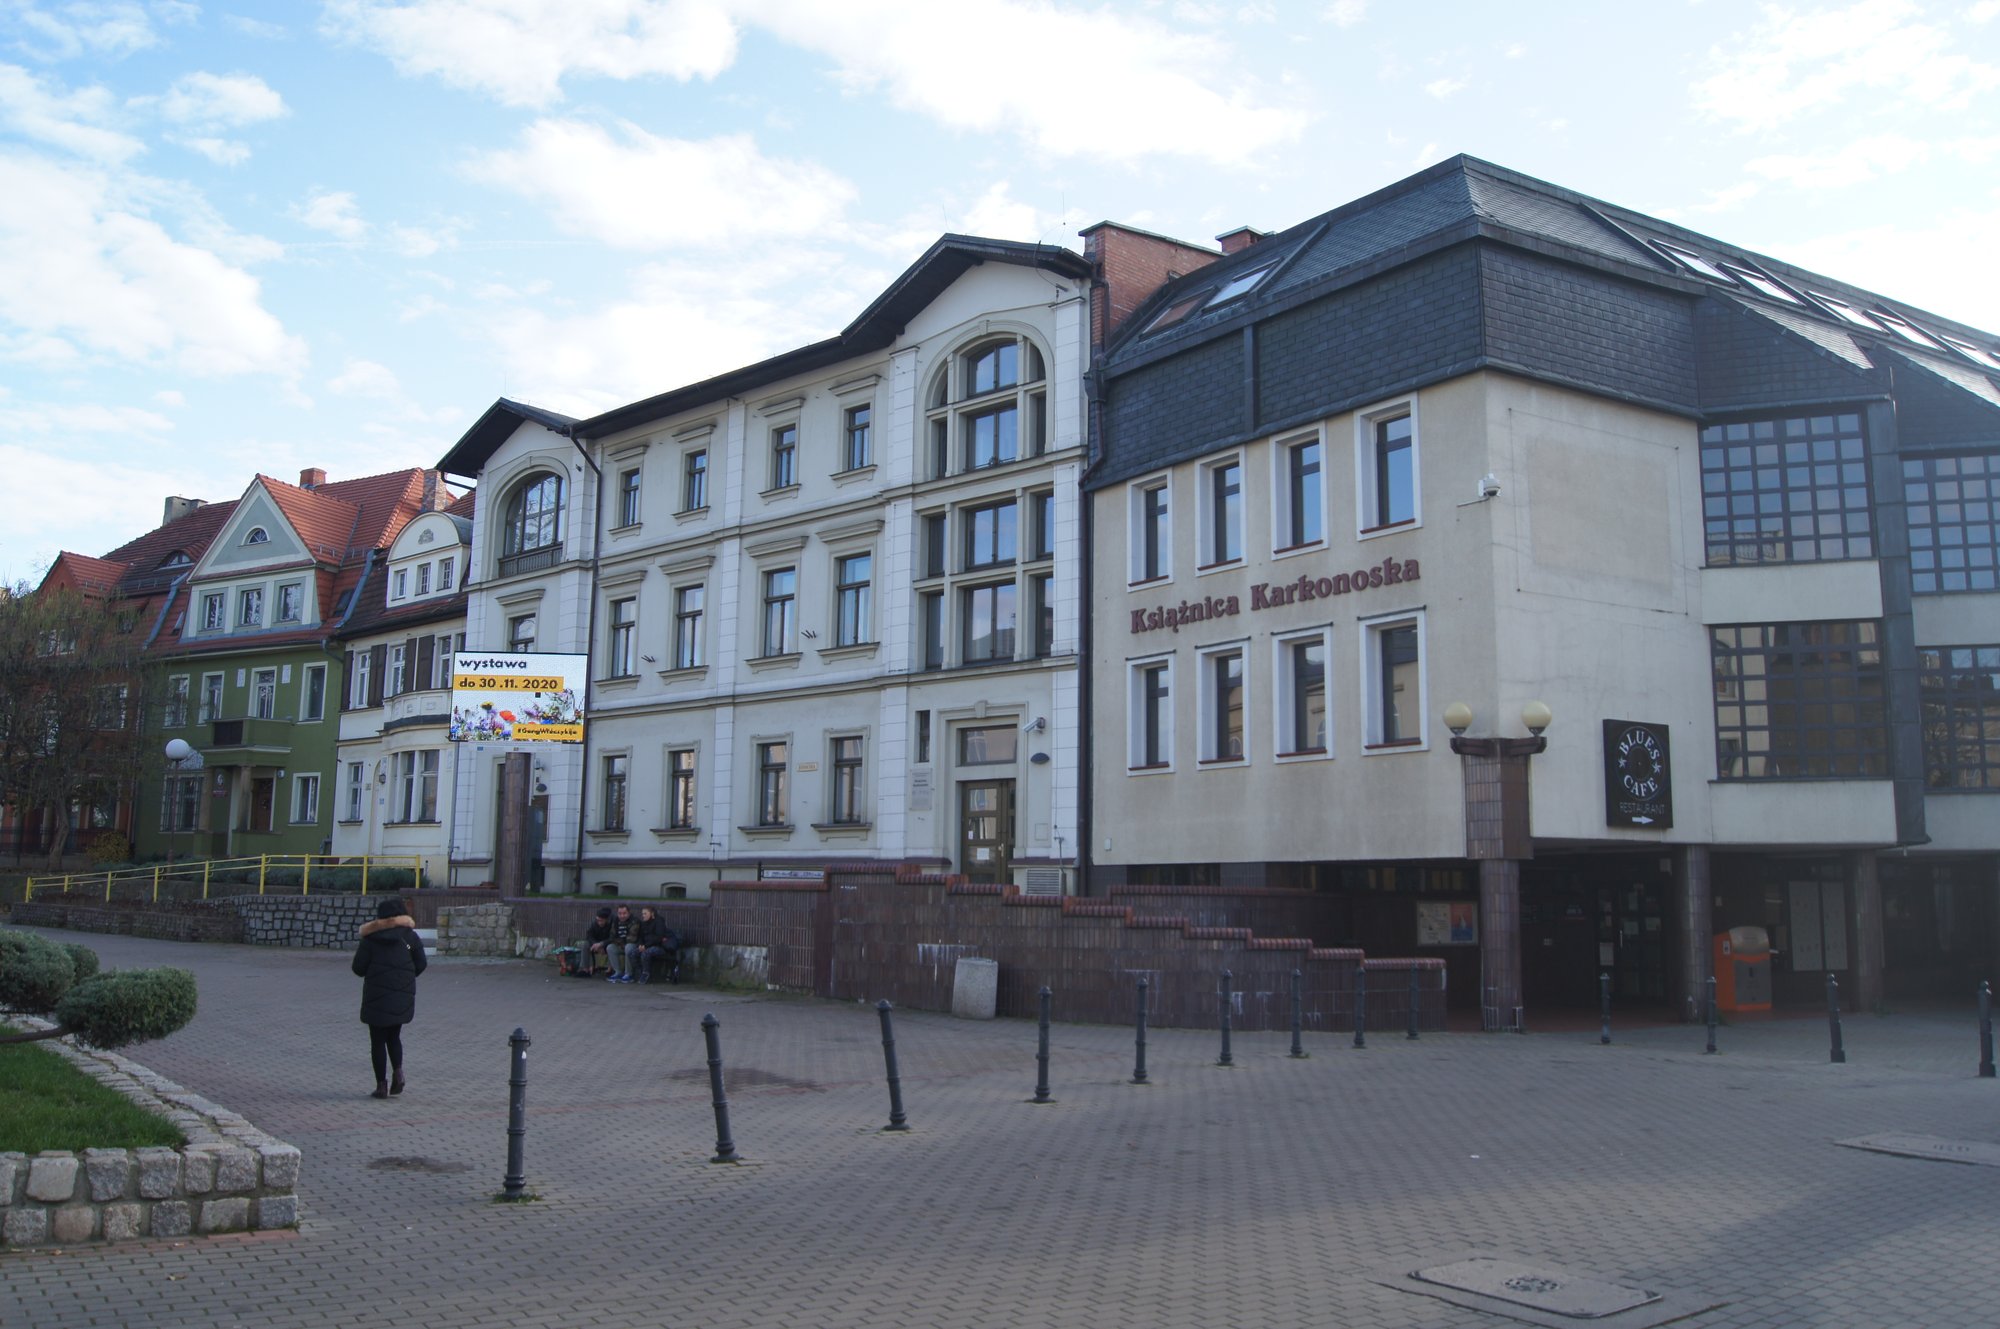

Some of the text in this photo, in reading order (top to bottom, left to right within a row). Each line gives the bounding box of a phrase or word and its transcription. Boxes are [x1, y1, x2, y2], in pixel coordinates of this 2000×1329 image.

[1130, 556, 1420, 633] Książnica Karkonoska
[459, 658, 527, 671] wystawa
[459, 677, 475, 688] do
[479, 678, 496, 688] 30
[523, 679, 558, 689] 2020
[1619, 730, 1660, 760] BLUES
[1624, 775, 1658, 797] CAFE
